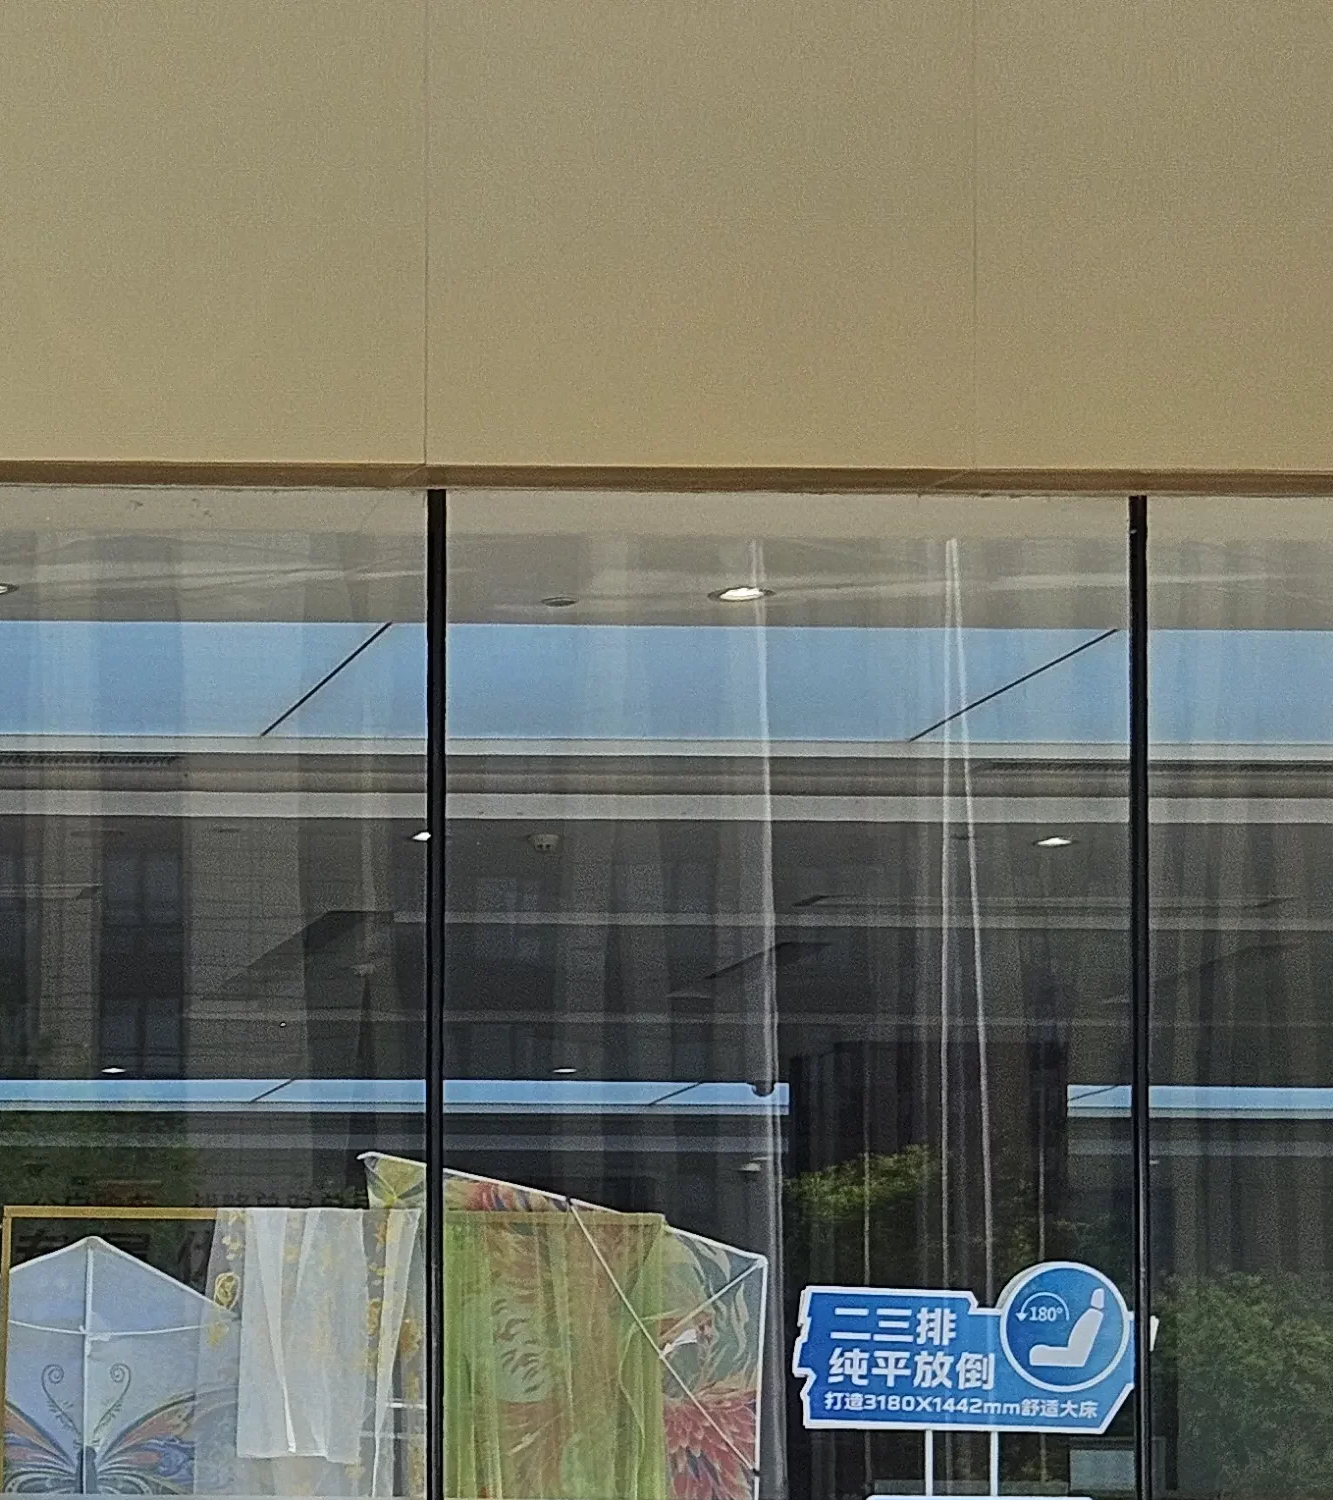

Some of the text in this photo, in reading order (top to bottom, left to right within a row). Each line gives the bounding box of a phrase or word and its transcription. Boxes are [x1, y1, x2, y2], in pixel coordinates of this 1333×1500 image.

[831, 1307, 958, 1347] 二三排
[1030, 1307, 1064, 1322] 180°
[828, 1349, 995, 1390] 纯平放倒
[824, 1391, 1099, 1420] 打造3180X1442mm舒适大床
